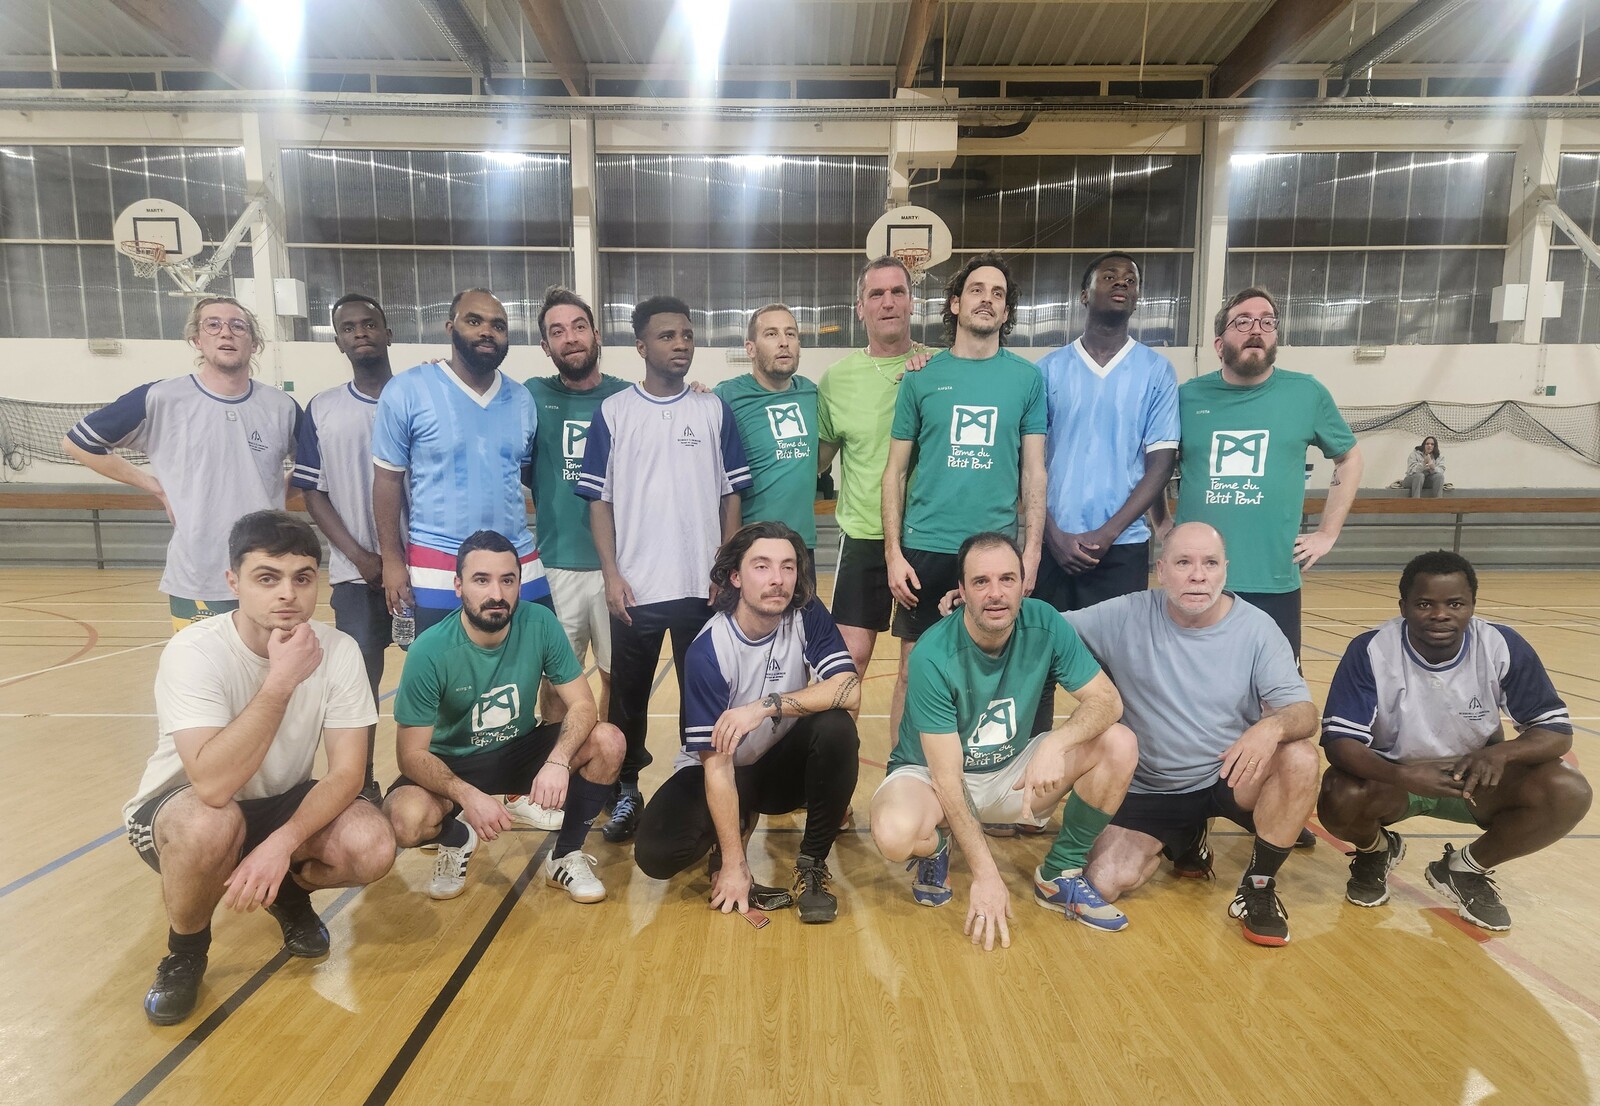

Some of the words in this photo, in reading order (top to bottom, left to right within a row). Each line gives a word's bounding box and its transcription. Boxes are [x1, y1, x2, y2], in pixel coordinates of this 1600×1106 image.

[776, 439, 797, 450] Ferme
[797, 437, 808, 447] du
[951, 445, 976, 457] Ferme
[977, 447, 991, 457] du
[775, 449, 793, 461] Petit
[794, 446, 811, 459] Pont
[947, 455, 970, 468] Petit
[971, 456, 994, 470] Pont
[1210, 477, 1240, 490] Ferme
[1242, 478, 1260, 490] du
[1205, 490, 1233, 504] Petit
[1234, 490, 1265, 505] Pont
[992, 748, 1015, 764] Pont
